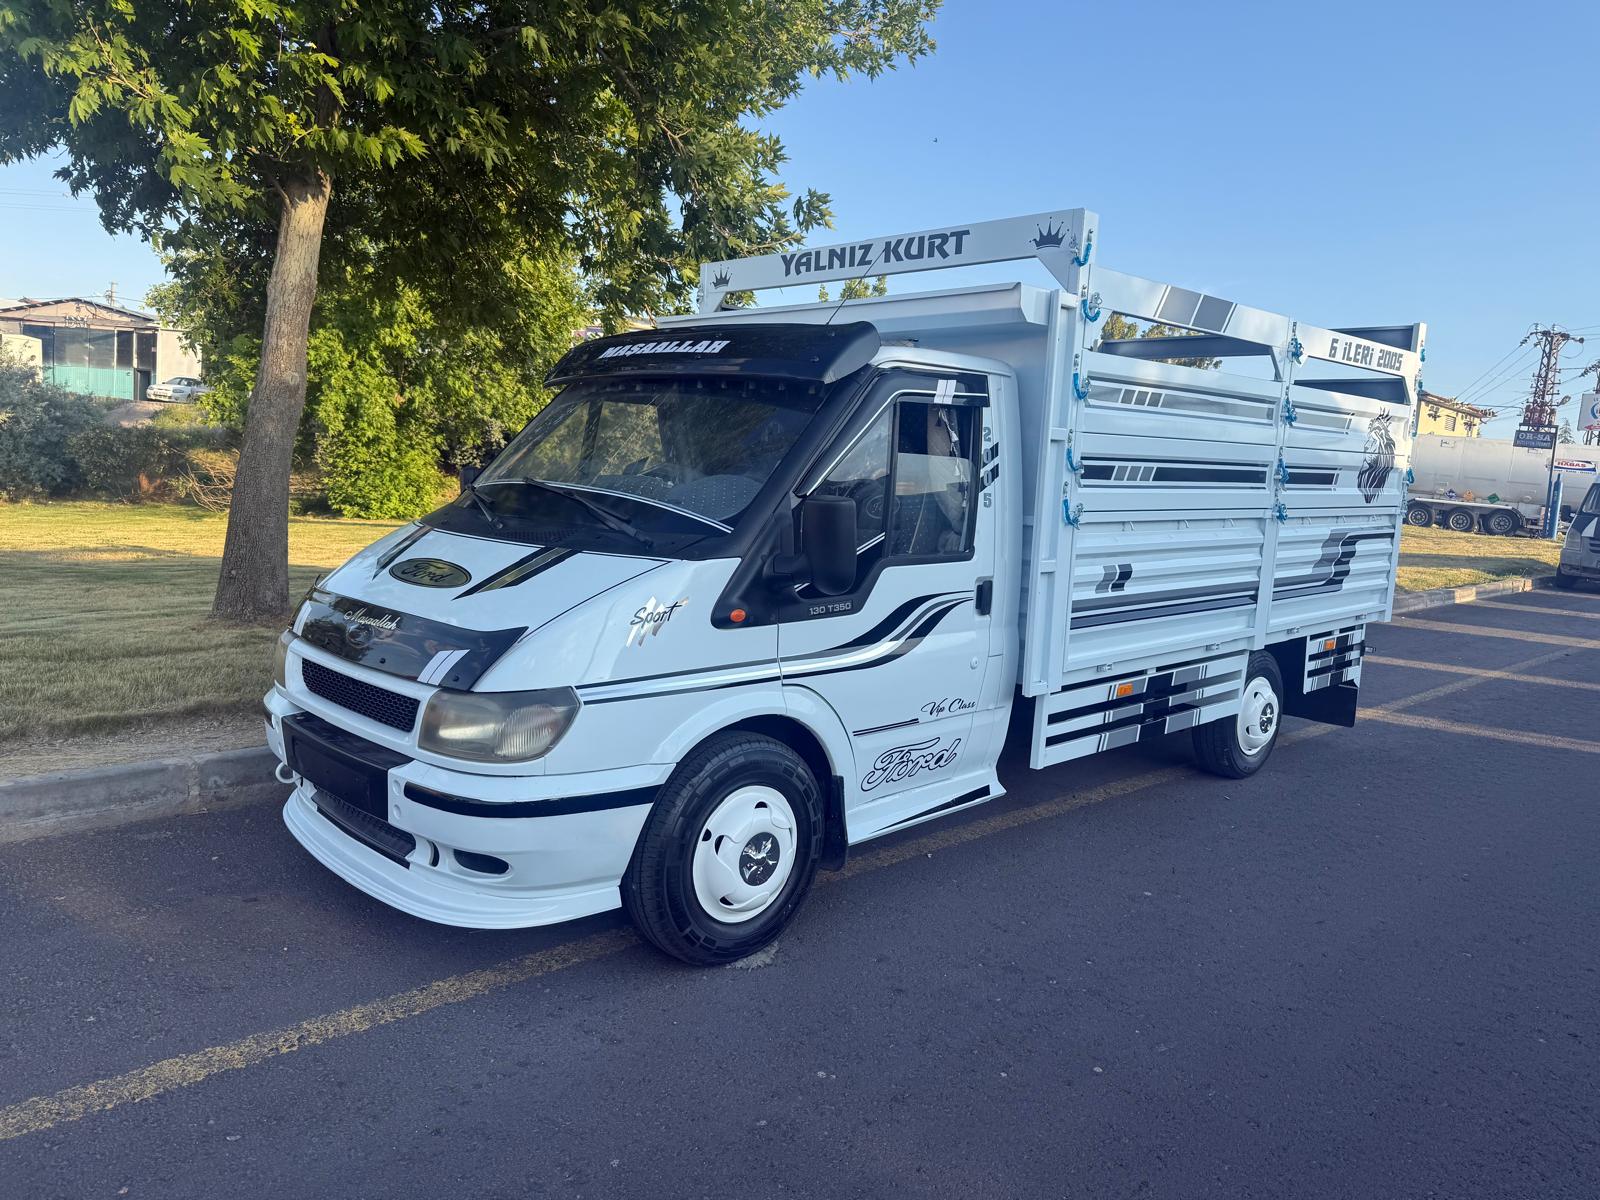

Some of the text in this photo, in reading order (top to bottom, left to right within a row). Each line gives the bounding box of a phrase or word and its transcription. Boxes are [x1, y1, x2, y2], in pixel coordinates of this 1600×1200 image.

[781, 229, 971, 276] YALNIZ KURT
[1329, 338, 1339, 358] 6
[1377, 349, 1403, 371] 2005
[401, 561, 453, 583] Ford
[630, 601, 683, 629] Sport
[809, 602, 852, 615] 130 T350
[920, 698, 976, 717] Vip Class
[861, 737, 961, 792] Ford
